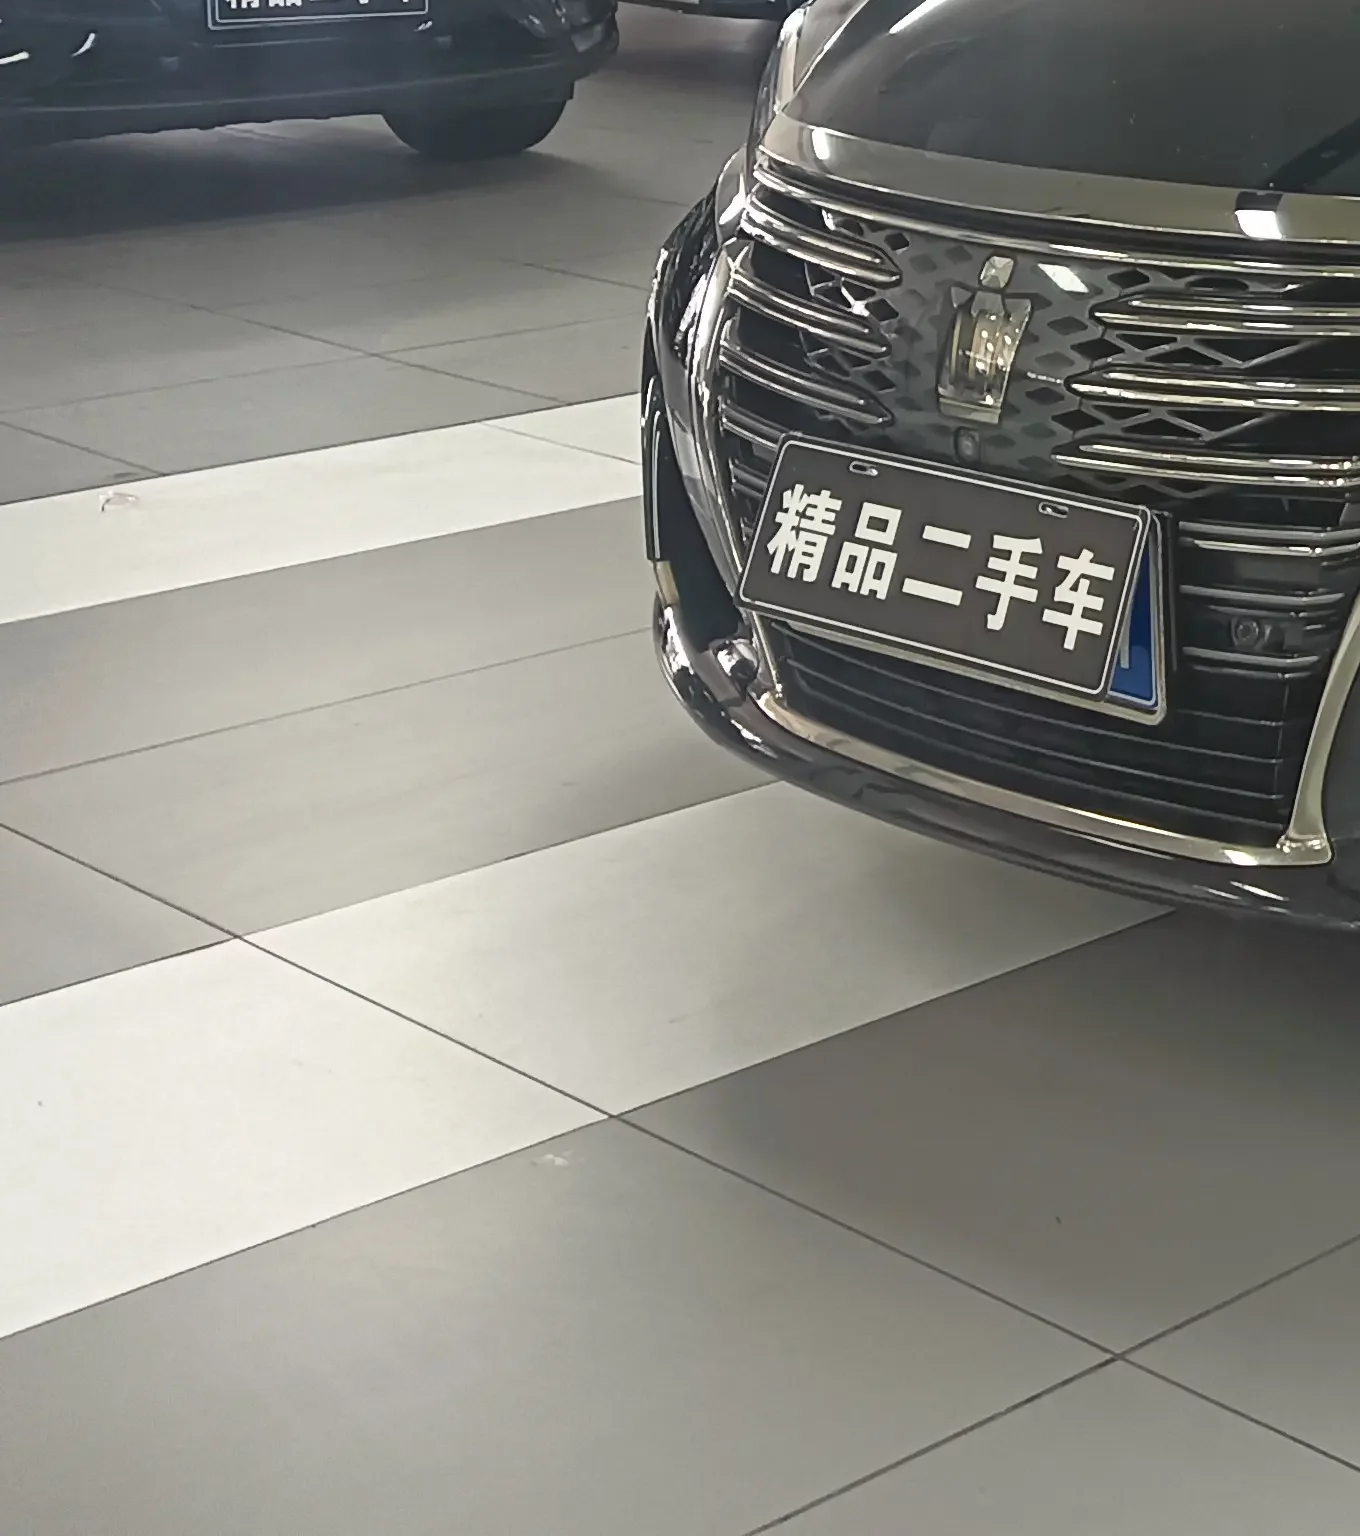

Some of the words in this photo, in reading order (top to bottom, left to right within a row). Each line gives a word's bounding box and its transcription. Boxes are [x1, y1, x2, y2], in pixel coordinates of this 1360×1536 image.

[767, 484, 1115, 651] 精品二手车
